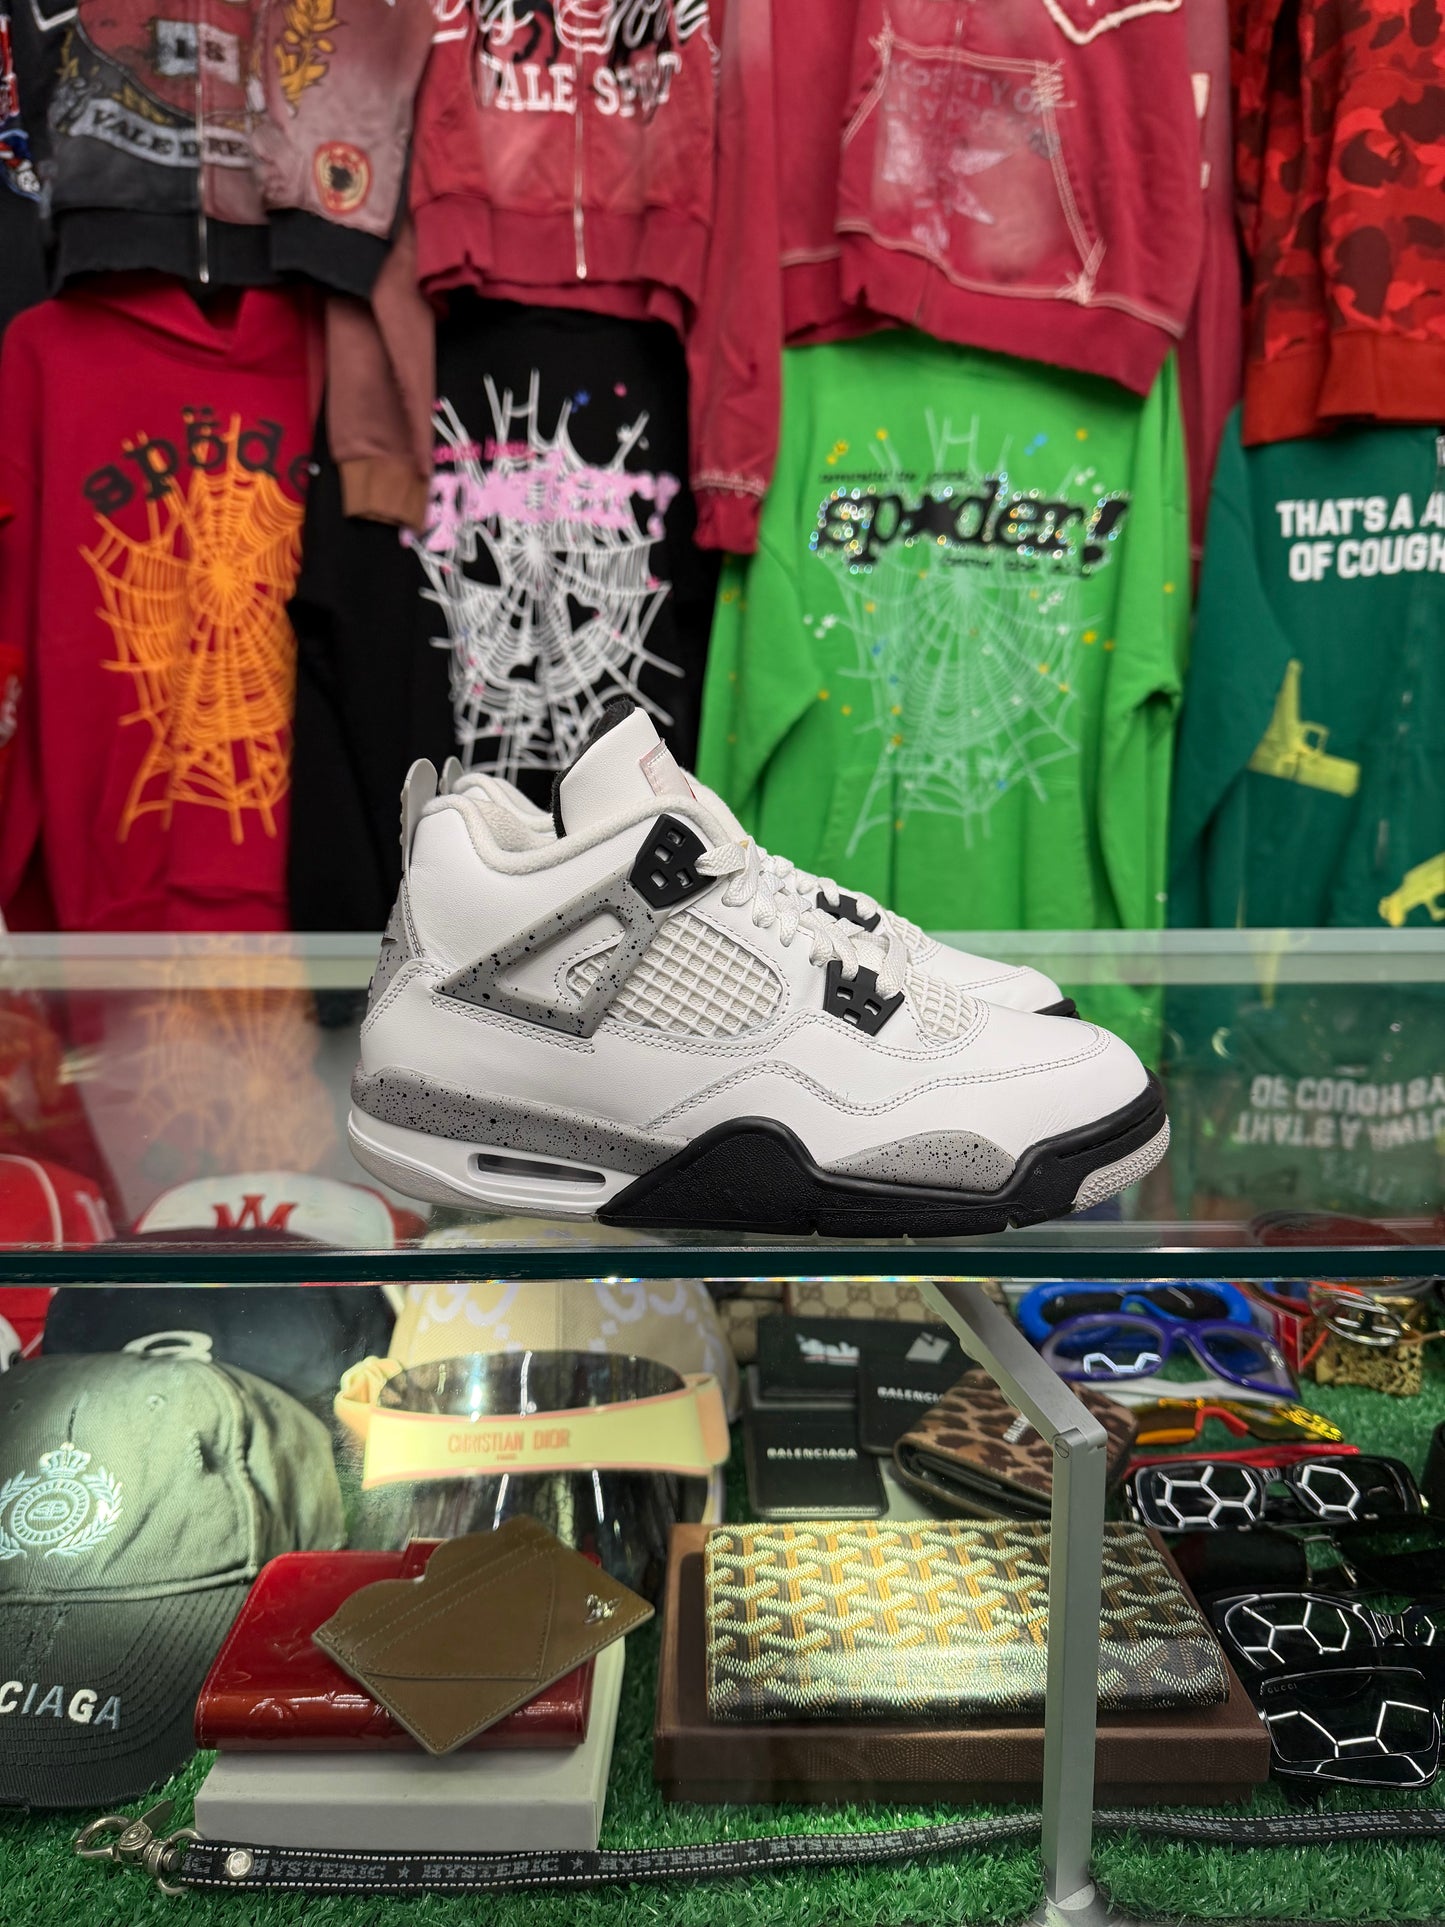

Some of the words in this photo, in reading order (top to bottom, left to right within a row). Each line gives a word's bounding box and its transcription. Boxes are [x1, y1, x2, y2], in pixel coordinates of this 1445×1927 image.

[93, 108, 173, 155] VALE
[1275, 496, 1388, 538] THAT'S
[1389, 493, 1414, 531] A
[1419, 491, 1445, 528] A
[1289, 541, 1335, 582] OF
[448, 1432, 524, 1454] CHRISTIAN
[533, 1428, 571, 1450] DIOR
[766, 1447, 858, 1460] BALENCIAGA
[1267, 1682, 1299, 1695] GUCCI
[421, 1854, 560, 1880] HYSTERIC
[599, 1848, 735, 1872] HYSTERIC
[1265, 1814, 1400, 1833] HYSTERIC
